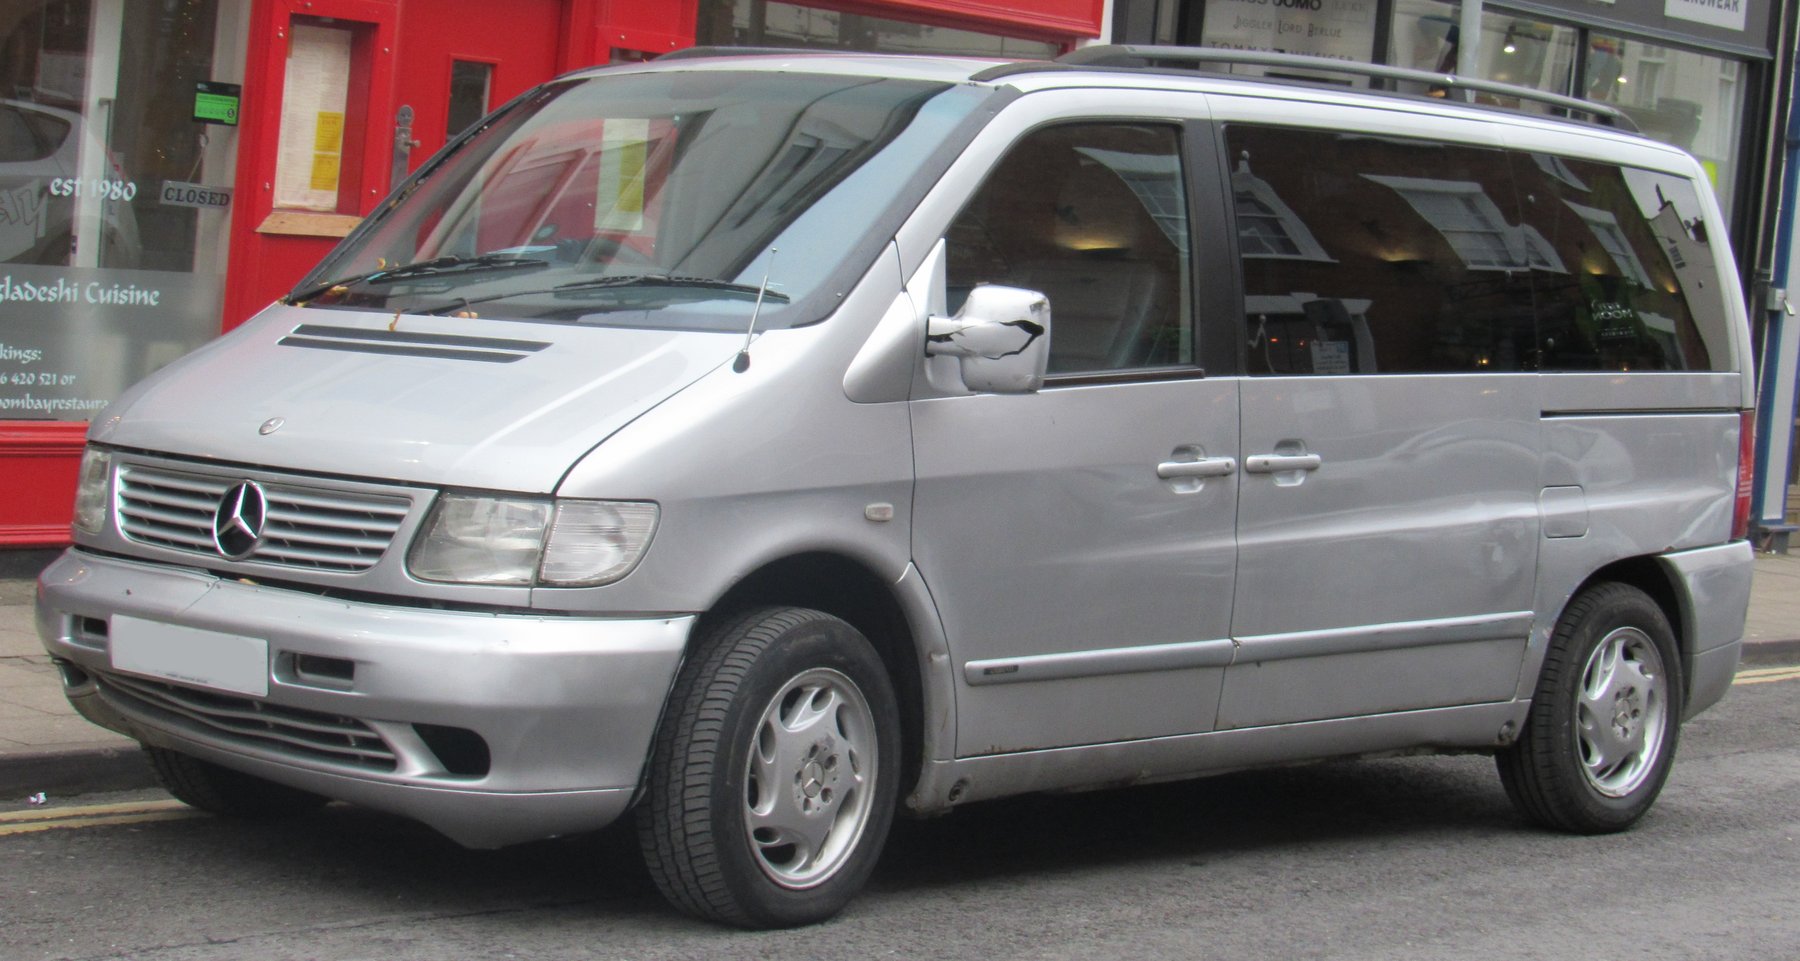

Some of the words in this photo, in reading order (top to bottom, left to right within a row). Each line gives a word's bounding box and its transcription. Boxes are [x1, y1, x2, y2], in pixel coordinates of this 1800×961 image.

[50, 177, 82, 197] est
[91, 179, 137, 201] 1980
[164, 187, 230, 206] CLOSED
[86, 282, 160, 306] Cuisine
[11, 373, 36, 385] 420
[39, 373, 57, 386] 521
[60, 374, 76, 386] or
